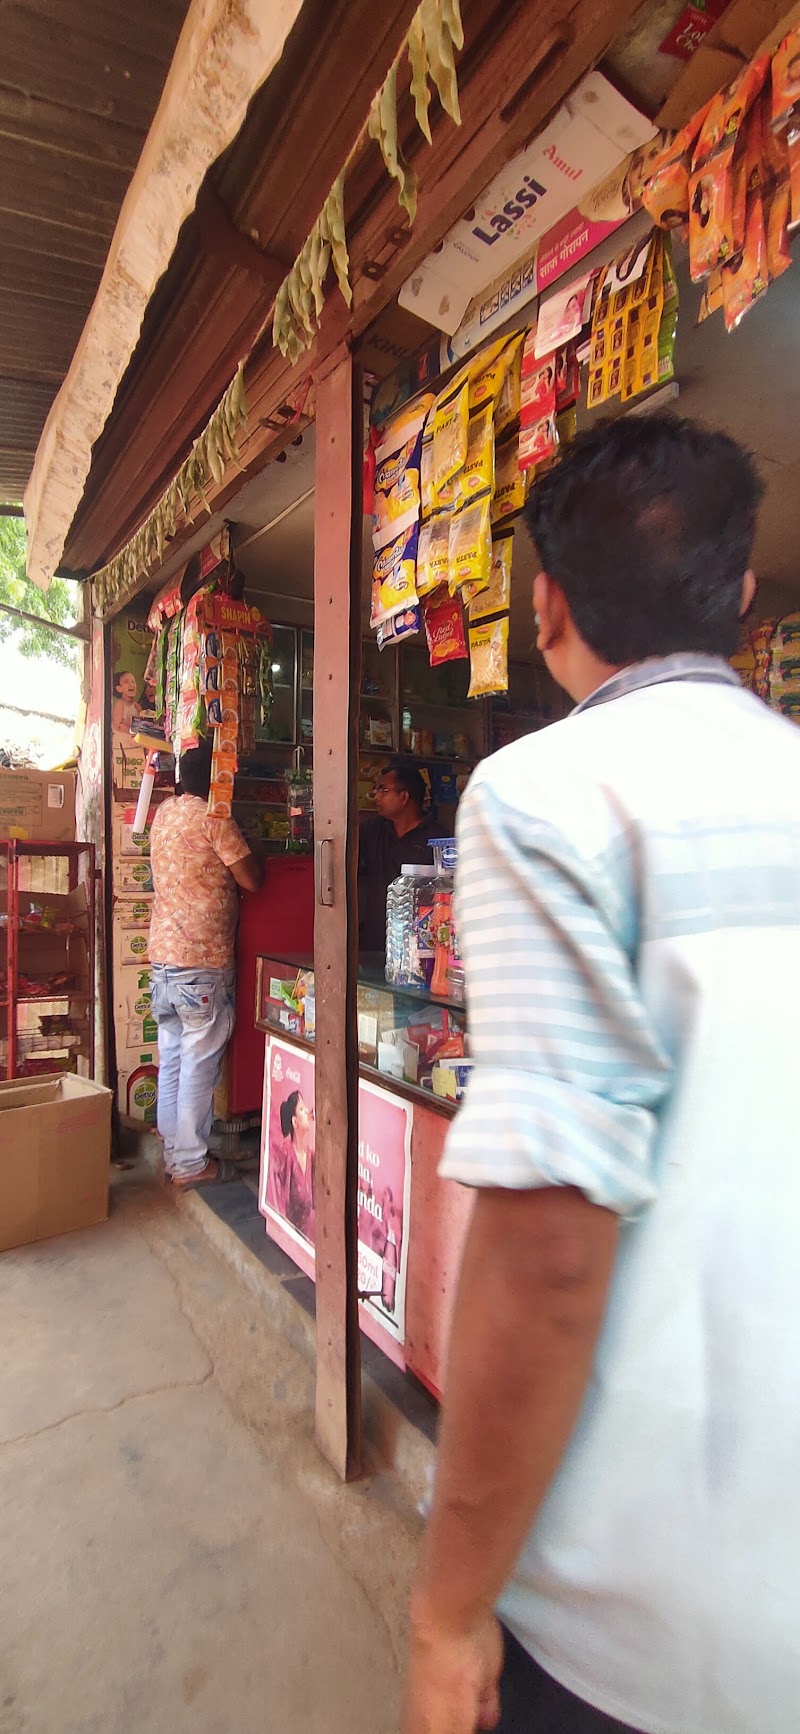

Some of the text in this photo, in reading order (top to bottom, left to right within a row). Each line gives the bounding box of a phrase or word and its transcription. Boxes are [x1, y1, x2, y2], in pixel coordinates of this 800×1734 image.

[543, 144, 583, 181] Amul
[472, 175, 547, 247] Lassi
[560, 229, 589, 261] गोरापन
[429, 557, 449, 568] ASTA
[456, 551, 478, 564] PASTA
[221, 605, 251, 625] SNAPIN
[470, 638, 492, 651] PASTA
[134, 1090, 156, 1101] Dettol
[366, 1144, 380, 1169] ko
